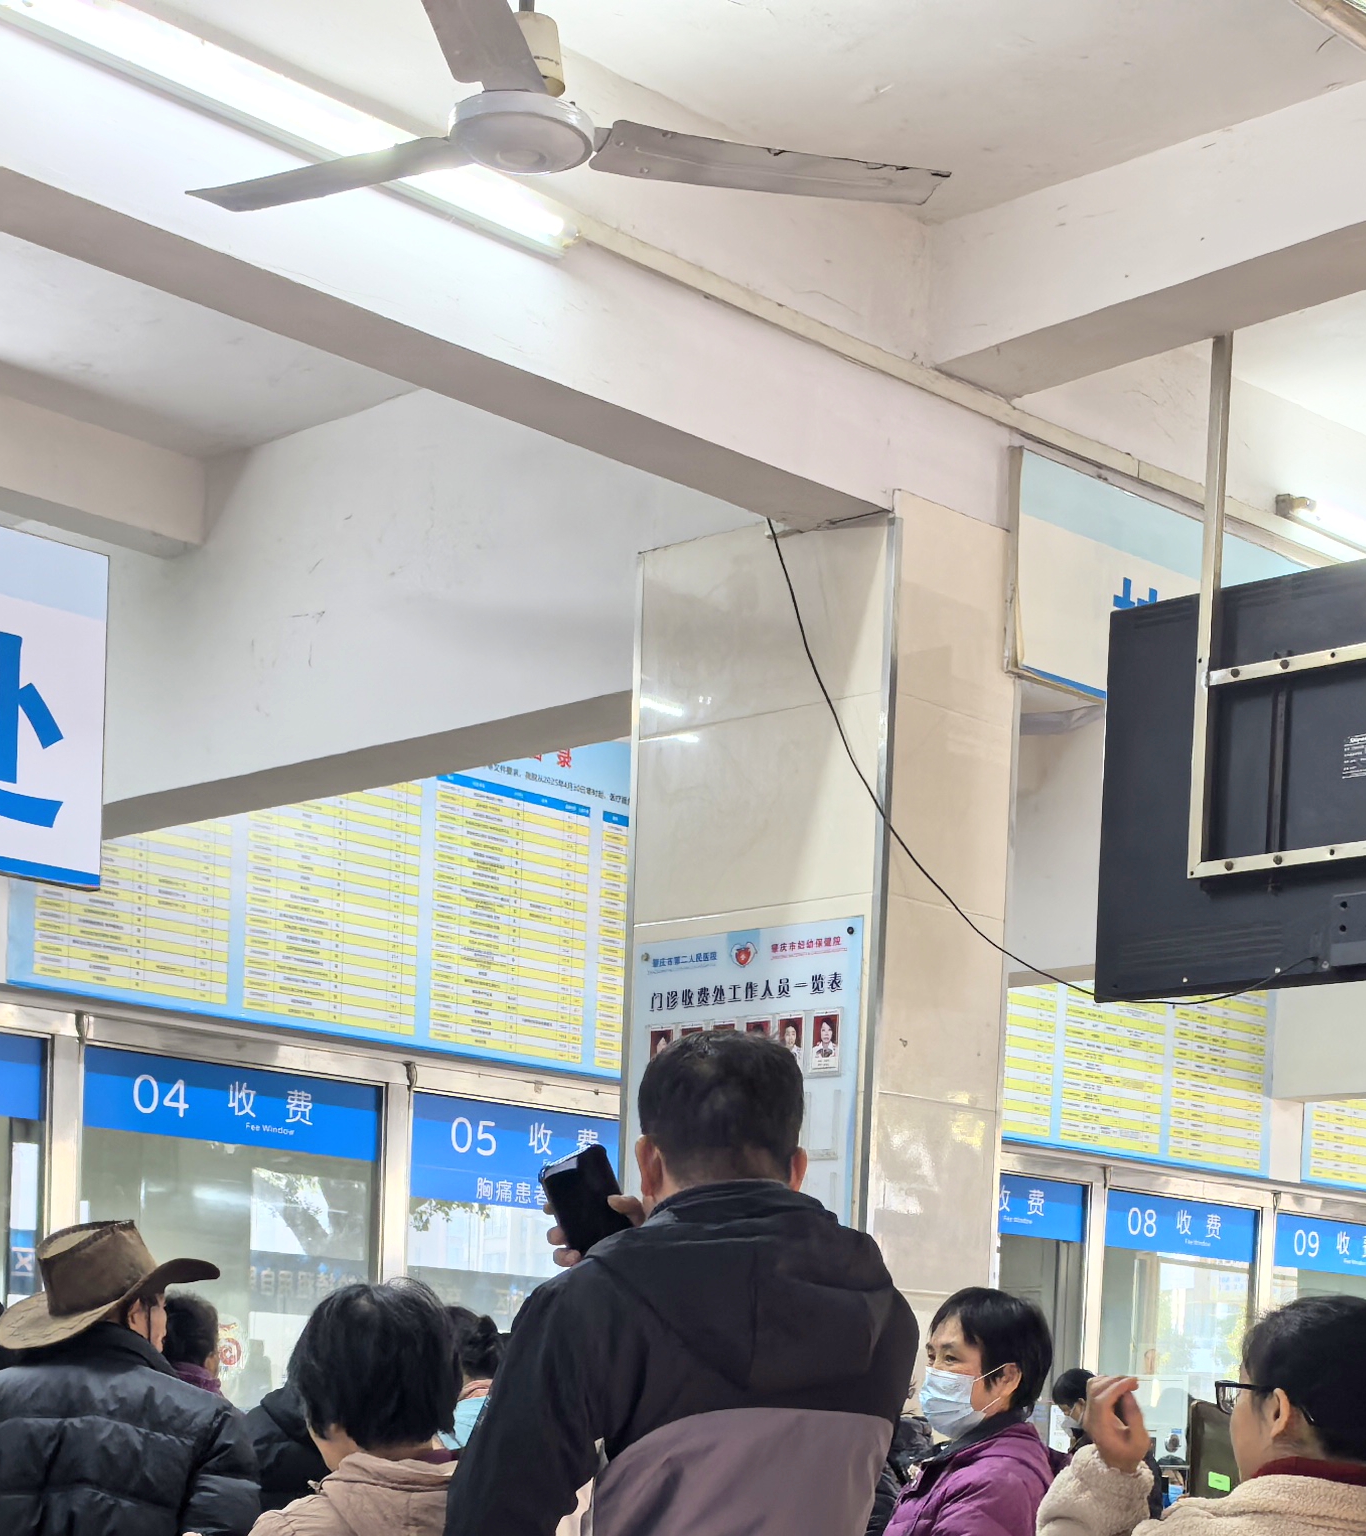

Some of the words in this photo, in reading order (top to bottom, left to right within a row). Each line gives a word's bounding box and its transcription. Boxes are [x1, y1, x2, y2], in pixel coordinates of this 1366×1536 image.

[649, 971, 843, 1011] 门诊收费处工作人员一览表
[133, 1074, 189, 1118] 04
[228, 1081, 312, 1125] 收费
[245, 1123, 260, 1131] Fee
[262, 1124, 295, 1136] Window
[450, 1116, 497, 1156] 05
[1127, 1207, 1158, 1238] 08
[1176, 1209, 1222, 1240] 收费
[1293, 1228, 1320, 1258] 09
